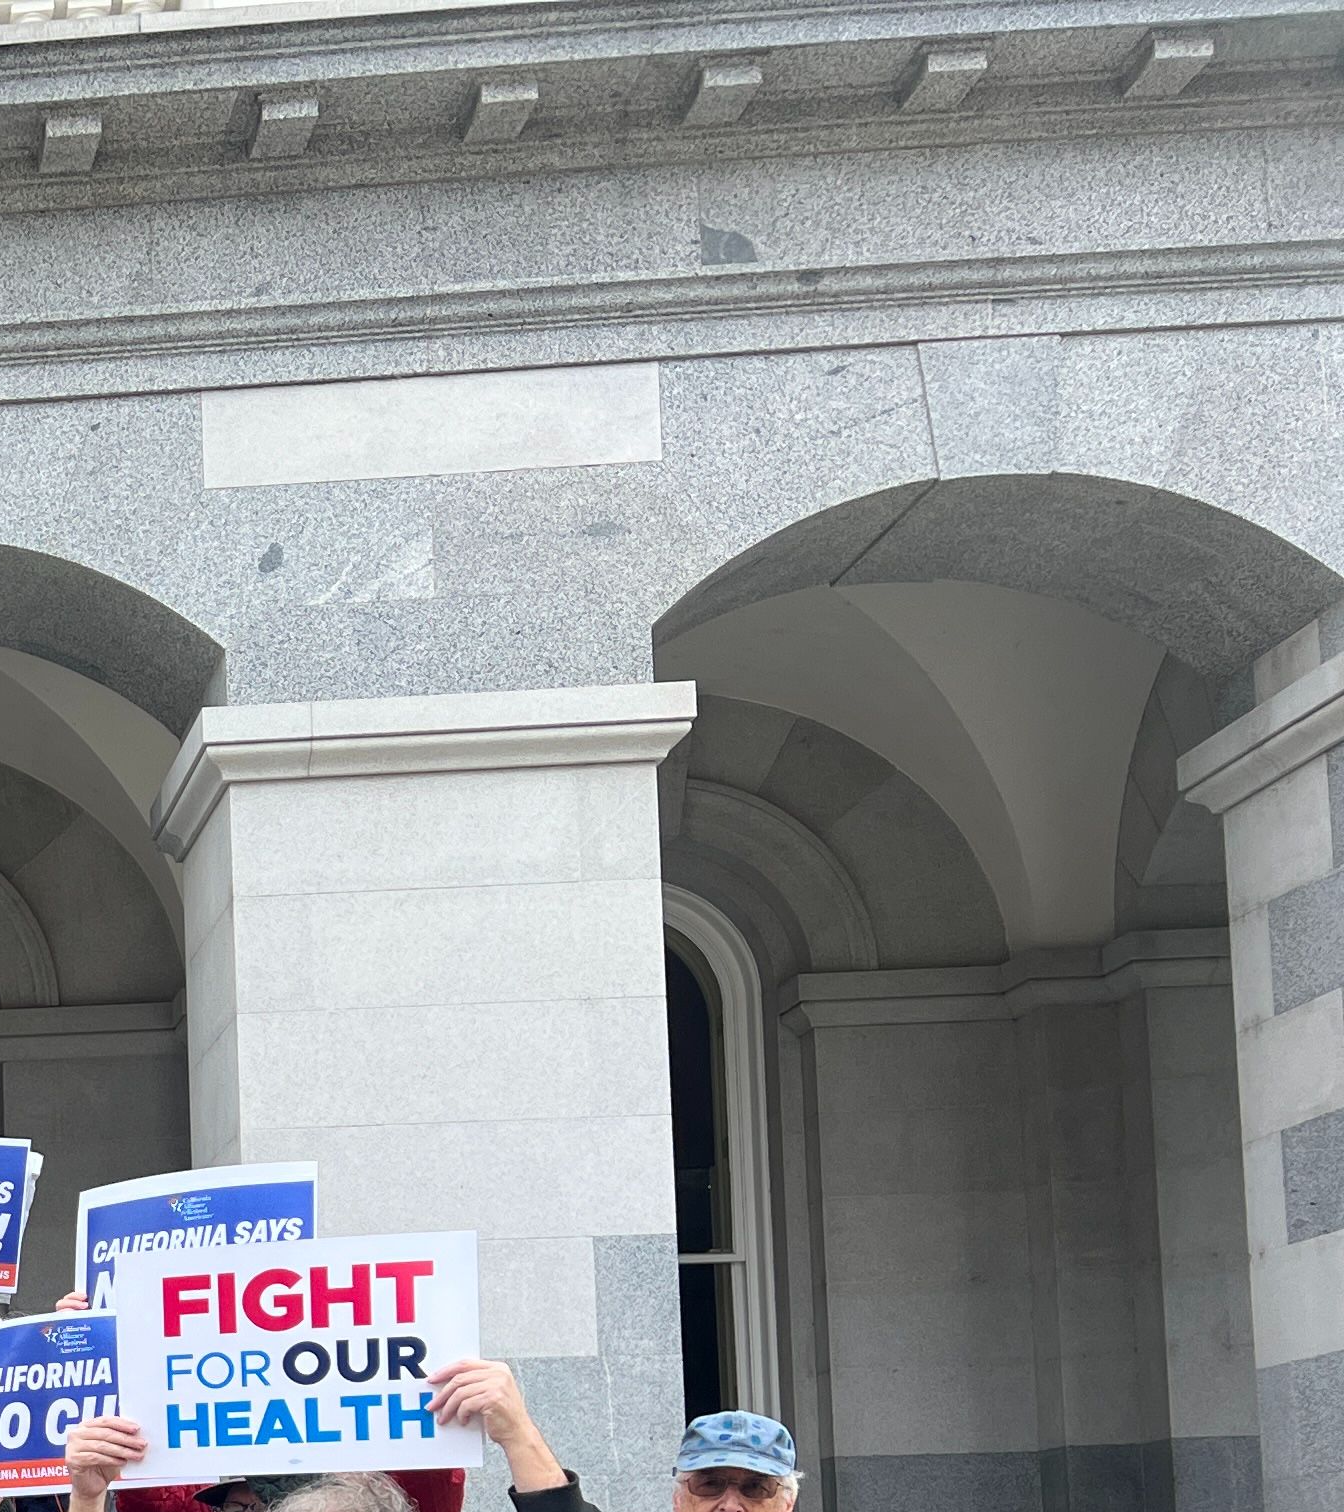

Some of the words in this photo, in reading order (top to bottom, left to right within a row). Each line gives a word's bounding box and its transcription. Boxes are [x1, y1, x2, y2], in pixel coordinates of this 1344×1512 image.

[93, 1224, 227, 1263] CALIFORNIA
[234, 1217, 303, 1244] SAYS
[163, 1260, 434, 1338] FIGHT
[166, 1350, 271, 1391] FOR
[282, 1336, 429, 1385] OUR
[166, 1391, 435, 1449] HEALTH
[20, 1465, 70, 1479] ALLIANCE
